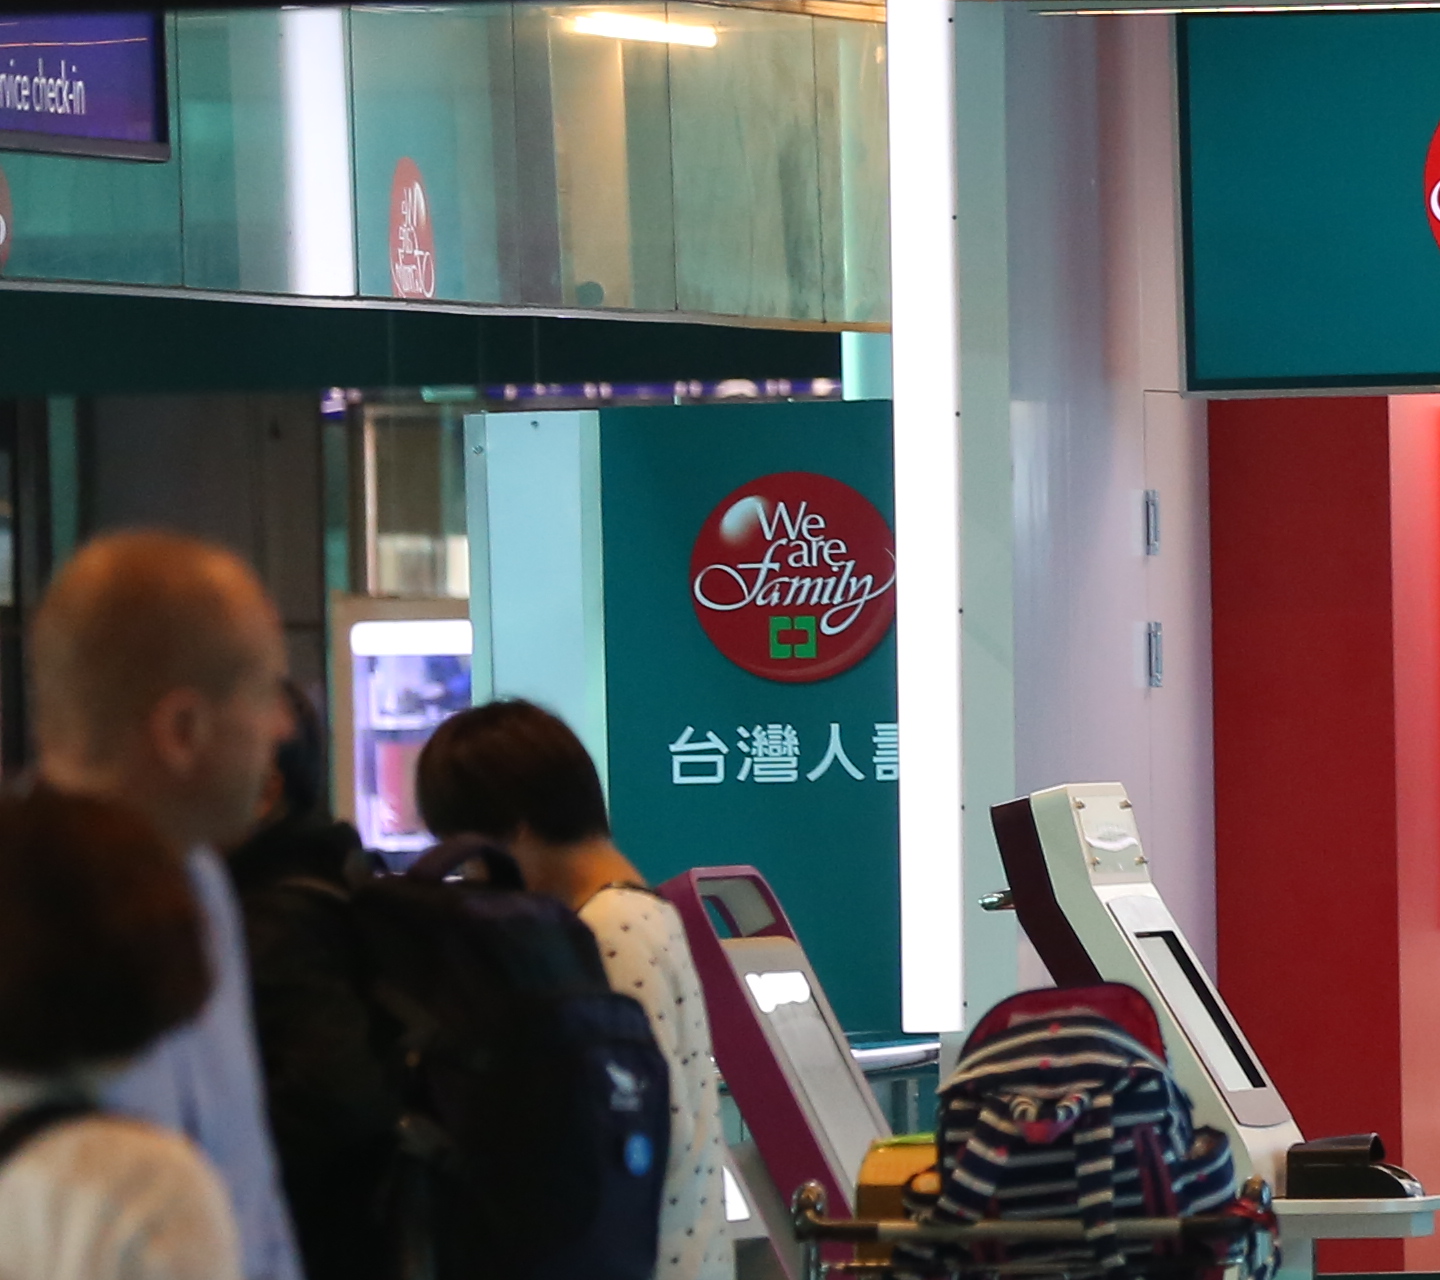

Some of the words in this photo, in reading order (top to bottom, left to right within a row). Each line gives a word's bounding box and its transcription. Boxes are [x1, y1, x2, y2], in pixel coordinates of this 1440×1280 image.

[756, 501, 825, 541] We
[787, 538, 848, 569] are
[693, 538, 896, 636] Family
